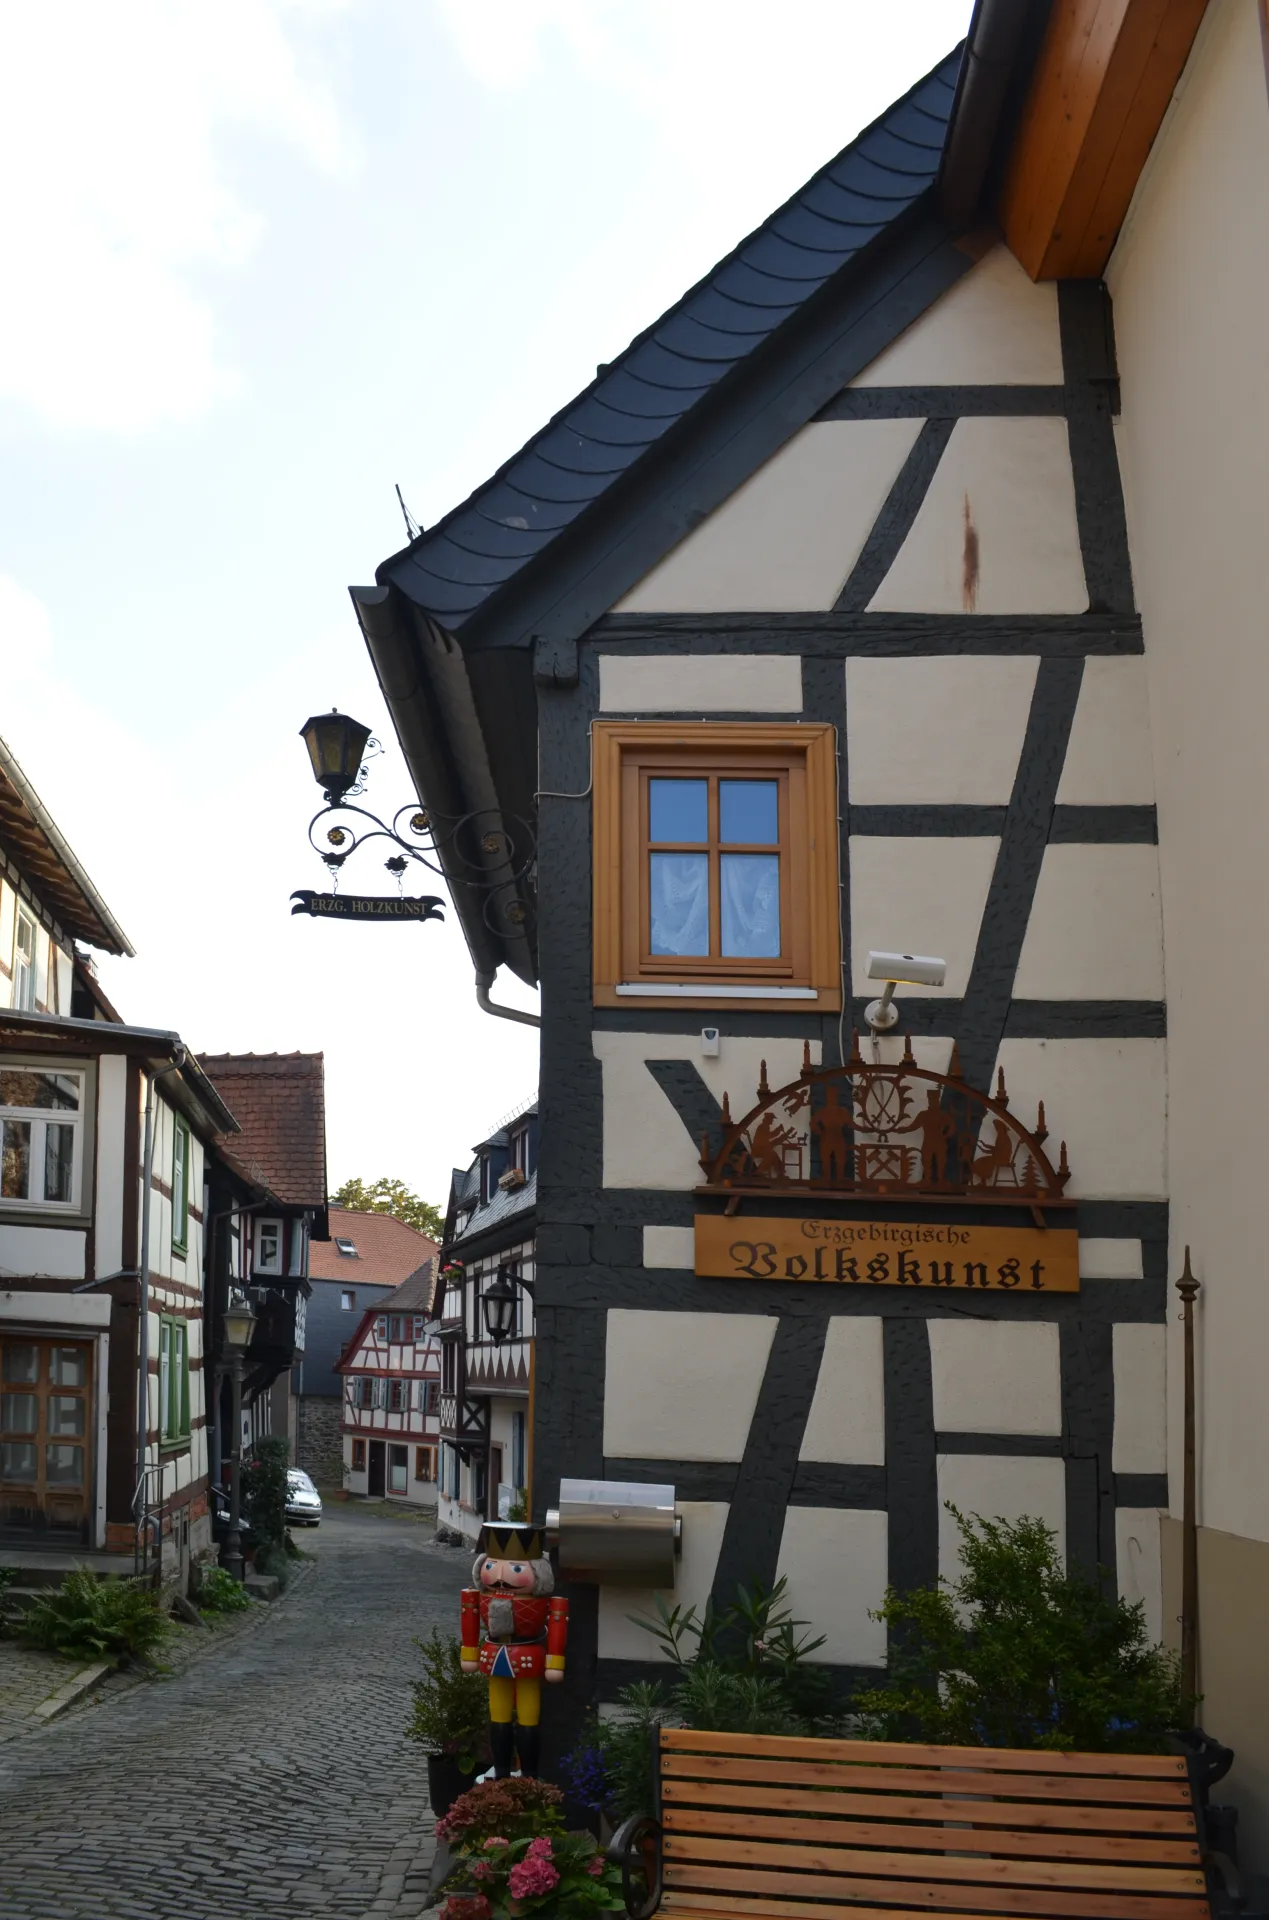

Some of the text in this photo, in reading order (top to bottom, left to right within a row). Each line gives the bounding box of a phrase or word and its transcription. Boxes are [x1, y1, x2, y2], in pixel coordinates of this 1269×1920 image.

[311, 898, 428, 915] ERZG. HOLZKUNST
[801, 1220, 971, 1247] Erzgebirgische
[729, 1240, 1046, 1290] Volkskunst
